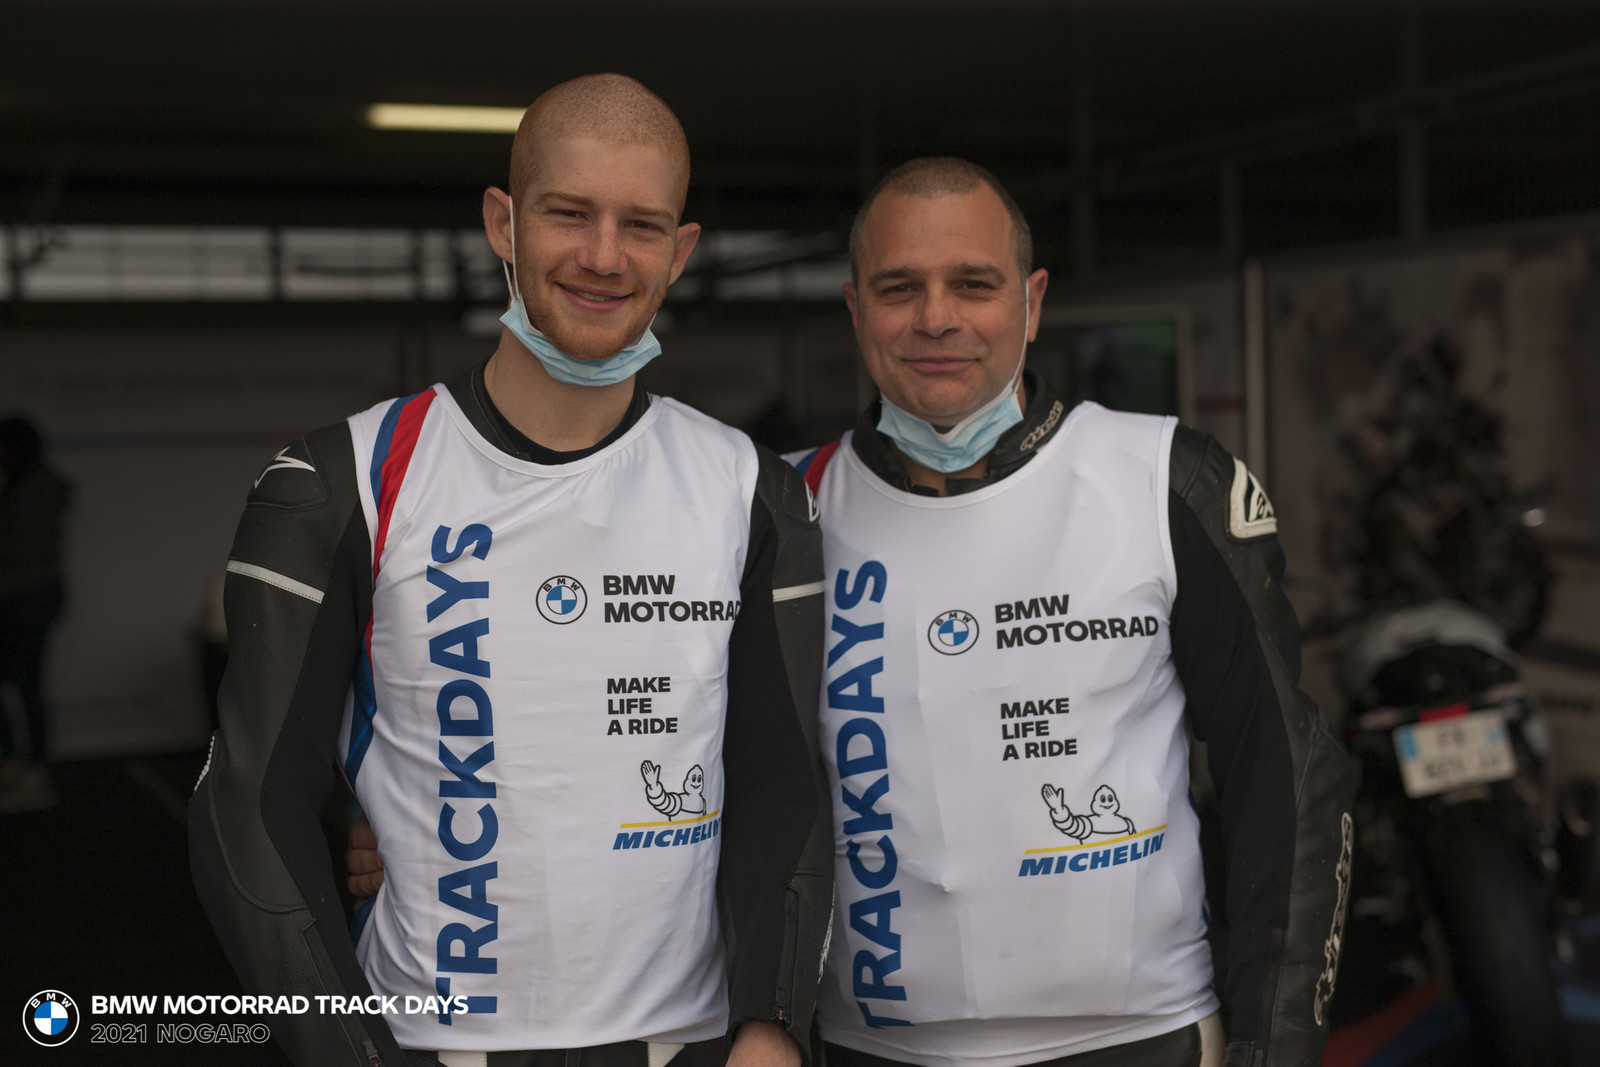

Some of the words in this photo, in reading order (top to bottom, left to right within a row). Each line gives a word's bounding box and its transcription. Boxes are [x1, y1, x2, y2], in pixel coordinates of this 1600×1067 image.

[603, 575, 675, 595] BMW
[995, 594, 1069, 623] BMW
[996, 616, 1159, 649] MOTORRAD
[607, 677, 671, 694] MAKE
[607, 698, 652, 714] LIFE
[1000, 698, 1070, 719] MAKE
[607, 720, 623, 735] A
[628, 717, 678, 734] RIDE
[1002, 720, 1050, 740] LIFE
[1002, 744, 1020, 761] A
[1024, 738, 1078, 759] RIDE
[426, 523, 499, 1026] TRACKDAYS
[827, 560, 916, 1029] TRACKDAYS
[1018, 832, 1165, 877] MICHELIN
